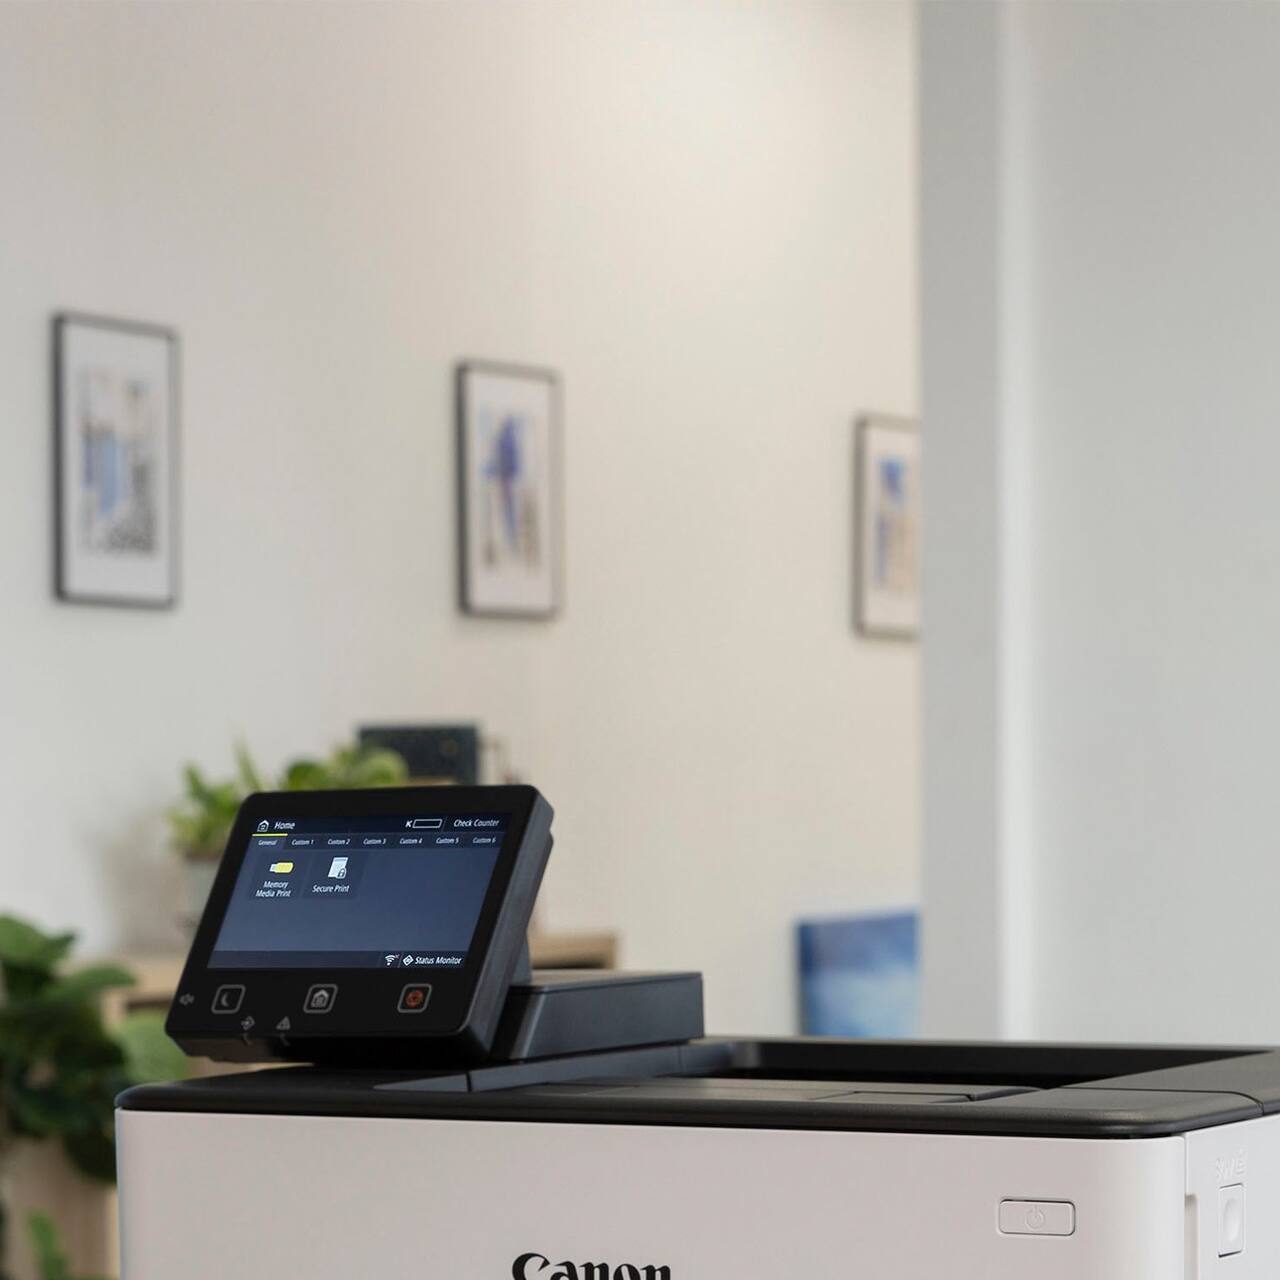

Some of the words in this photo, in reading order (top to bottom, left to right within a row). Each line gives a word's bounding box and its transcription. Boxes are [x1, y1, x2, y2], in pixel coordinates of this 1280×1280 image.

[274, 821, 295, 830] Home
[453, 819, 472, 827] Check
[473, 819, 499, 827] Counter
[263, 881, 288, 889] Memory
[312, 885, 333, 893] Secure
[255, 889, 275, 898] Media
[415, 956, 434, 964] Status
[435, 956, 462, 964] Monitor
